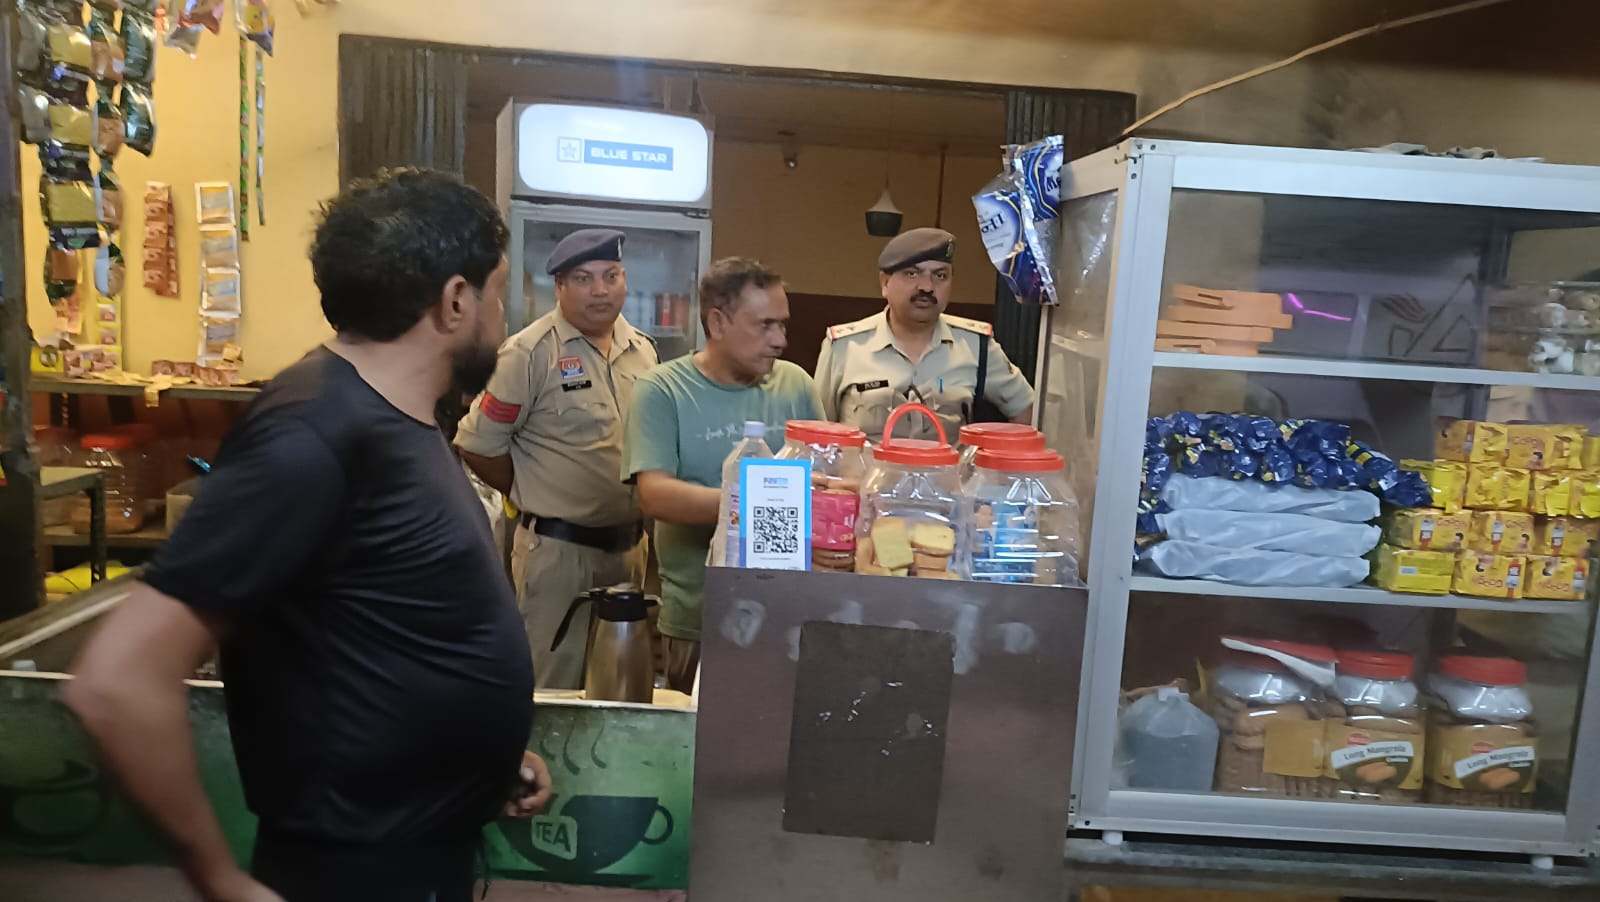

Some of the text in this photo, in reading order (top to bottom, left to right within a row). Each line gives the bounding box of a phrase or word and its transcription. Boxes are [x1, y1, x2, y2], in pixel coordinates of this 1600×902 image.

[591, 147, 667, 164] BLUE STAR
[534, 821, 571, 853] TEA
